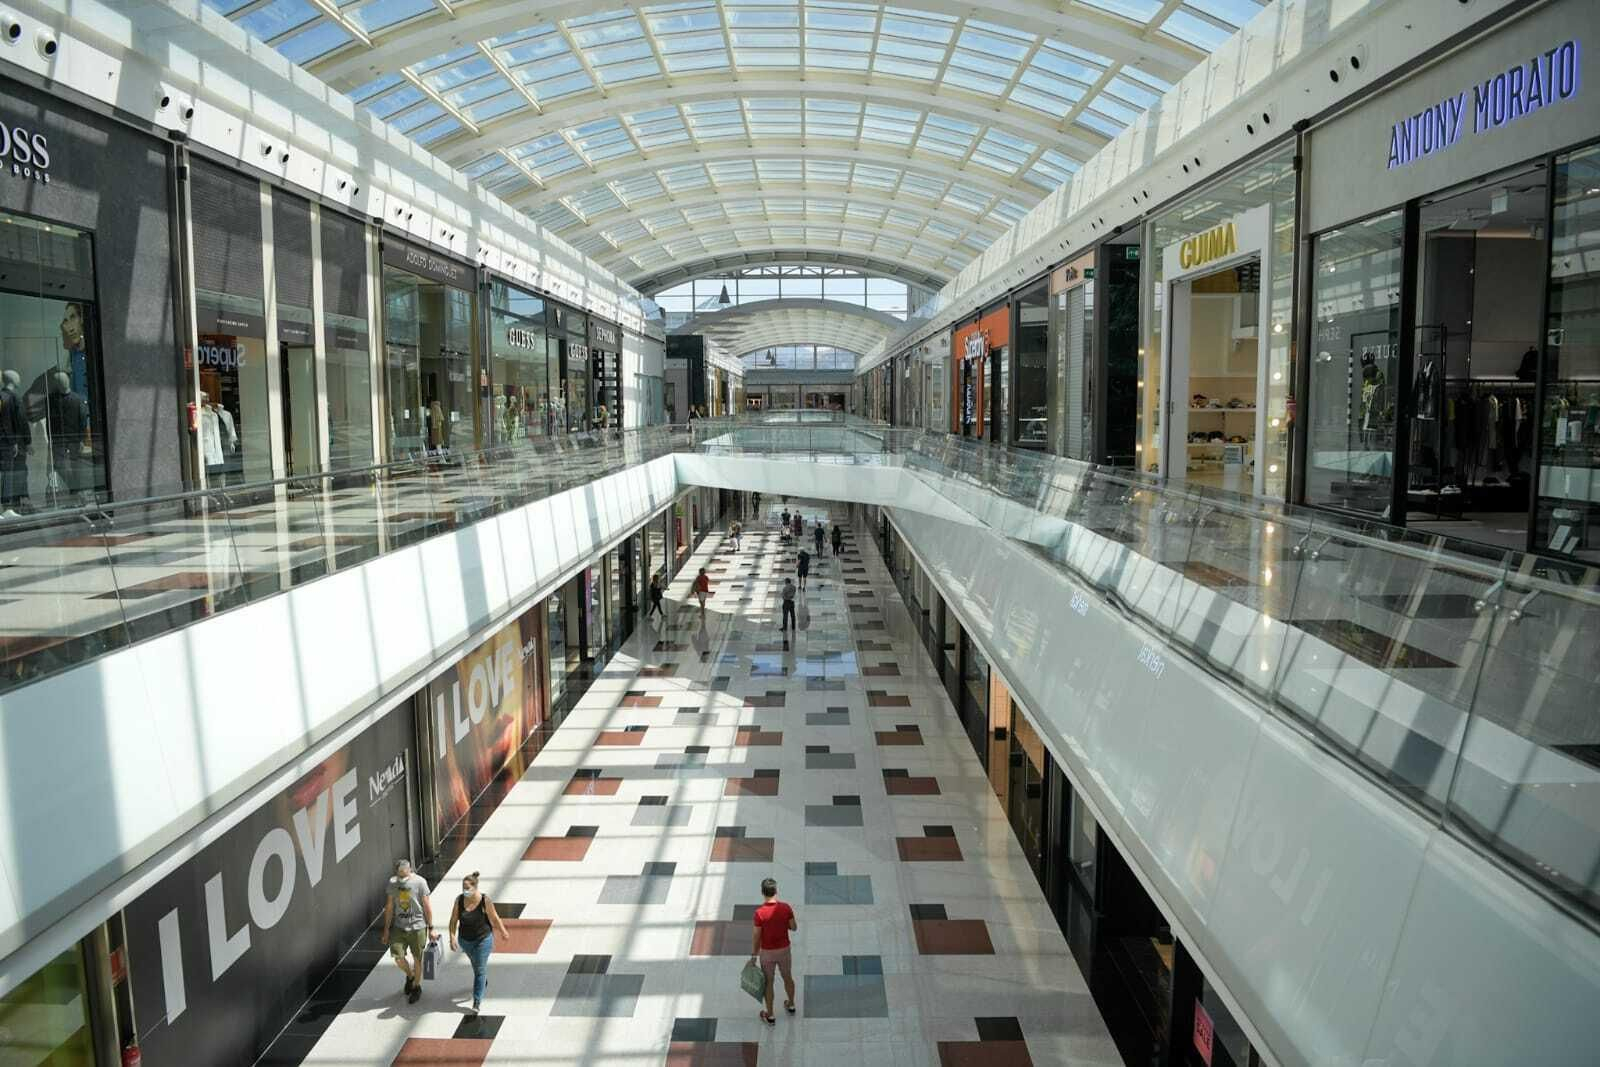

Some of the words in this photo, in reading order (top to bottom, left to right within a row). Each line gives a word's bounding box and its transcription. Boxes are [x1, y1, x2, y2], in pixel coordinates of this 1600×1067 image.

[1388, 90, 1467, 169] ANTONY
[1473, 40, 1580, 134] MORATO
[13, 163, 50, 183] BOSS
[508, 327, 536, 351] GUESS
[437, 692, 447, 760] I
[452, 640, 515, 744] LOVE
[158, 907, 187, 1026] I
[204, 767, 362, 983] LOVE
